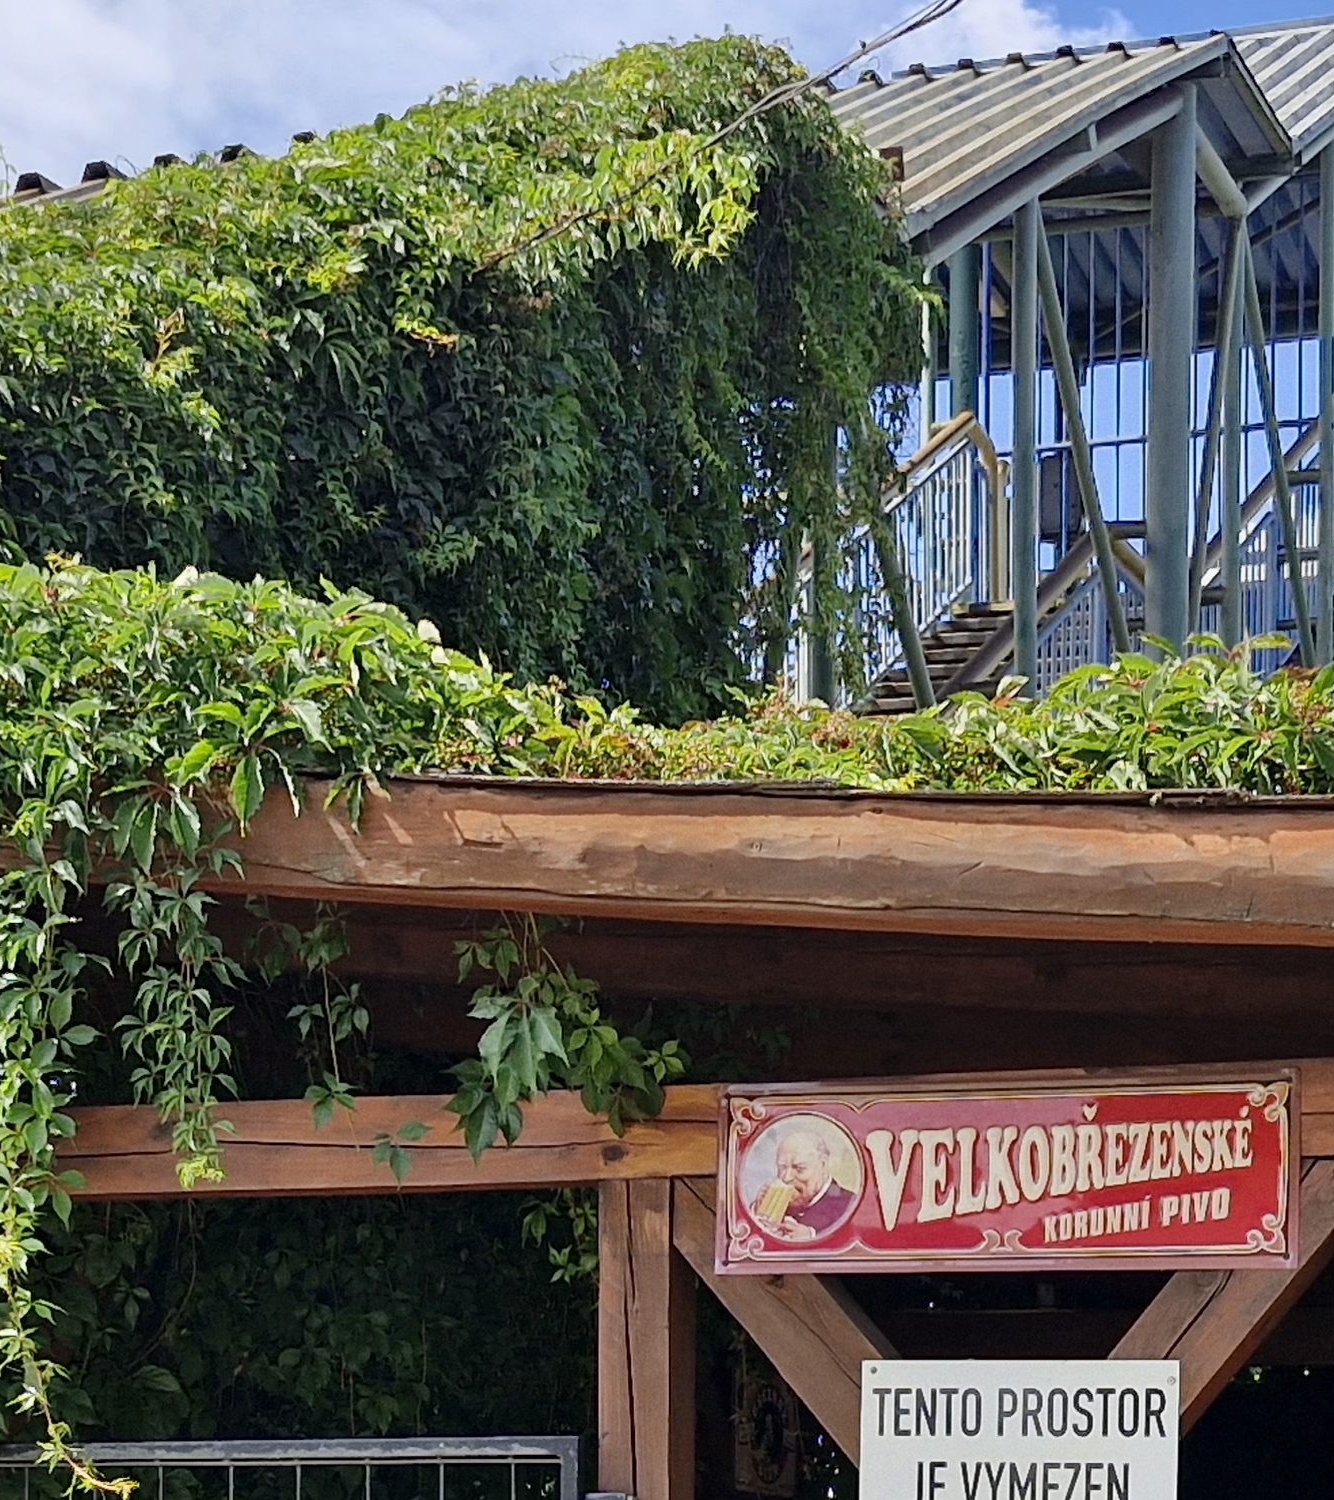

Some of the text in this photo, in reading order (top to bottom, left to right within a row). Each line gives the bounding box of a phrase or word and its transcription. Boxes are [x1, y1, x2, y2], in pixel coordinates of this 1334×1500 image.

[865, 1103, 1254, 1231] VELKOBŘEZENSKÉ
[1043, 1187, 1231, 1243] KORUNNÍ PIVO
[872, 1387, 1167, 1438] TENTO PROSTOR
